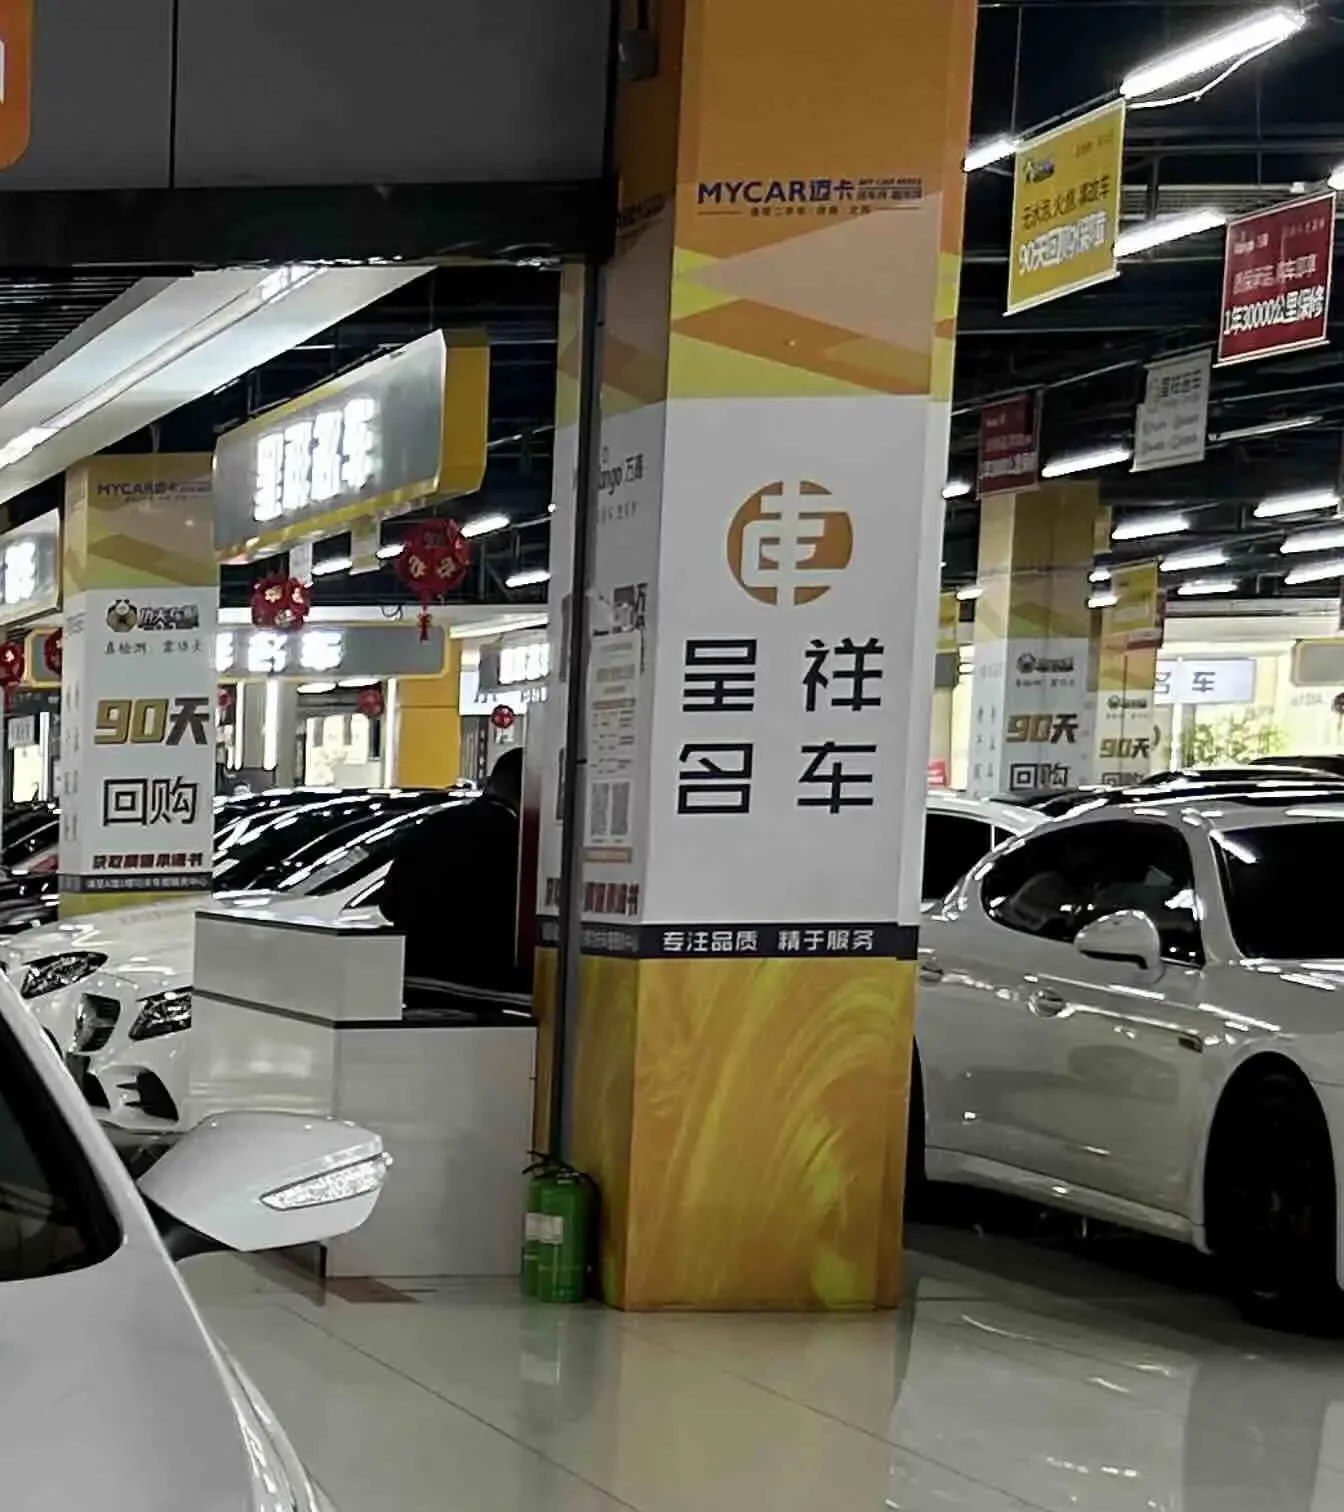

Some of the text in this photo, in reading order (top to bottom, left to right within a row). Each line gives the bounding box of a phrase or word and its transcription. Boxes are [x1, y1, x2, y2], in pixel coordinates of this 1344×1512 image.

[94, 698, 209, 745] 90天
[1006, 714, 1078, 744] 90天
[677, 740, 877, 816] 名车
[1010, 763, 1069, 790] 回购
[103, 776, 198, 826] 回购
[663, 929, 875, 951] 专注品质 精于服务
